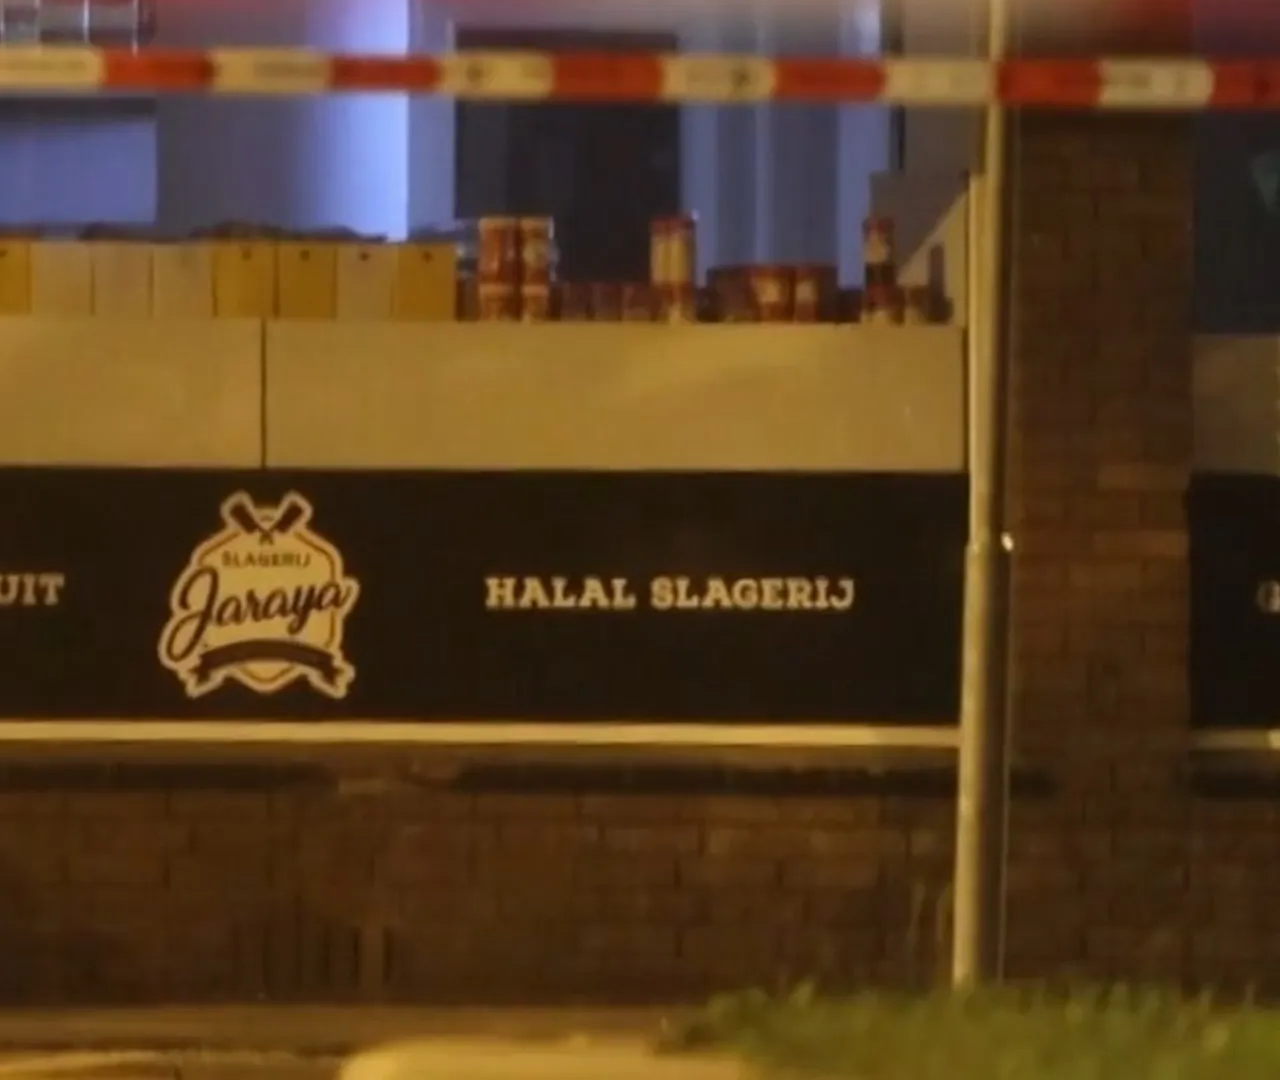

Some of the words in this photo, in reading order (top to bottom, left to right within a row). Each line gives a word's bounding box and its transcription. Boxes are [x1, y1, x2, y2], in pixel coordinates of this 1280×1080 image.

[166, 566, 354, 663] Jaraya
[484, 576, 638, 611] HALAL
[650, 576, 856, 611] SLAGERIJ
